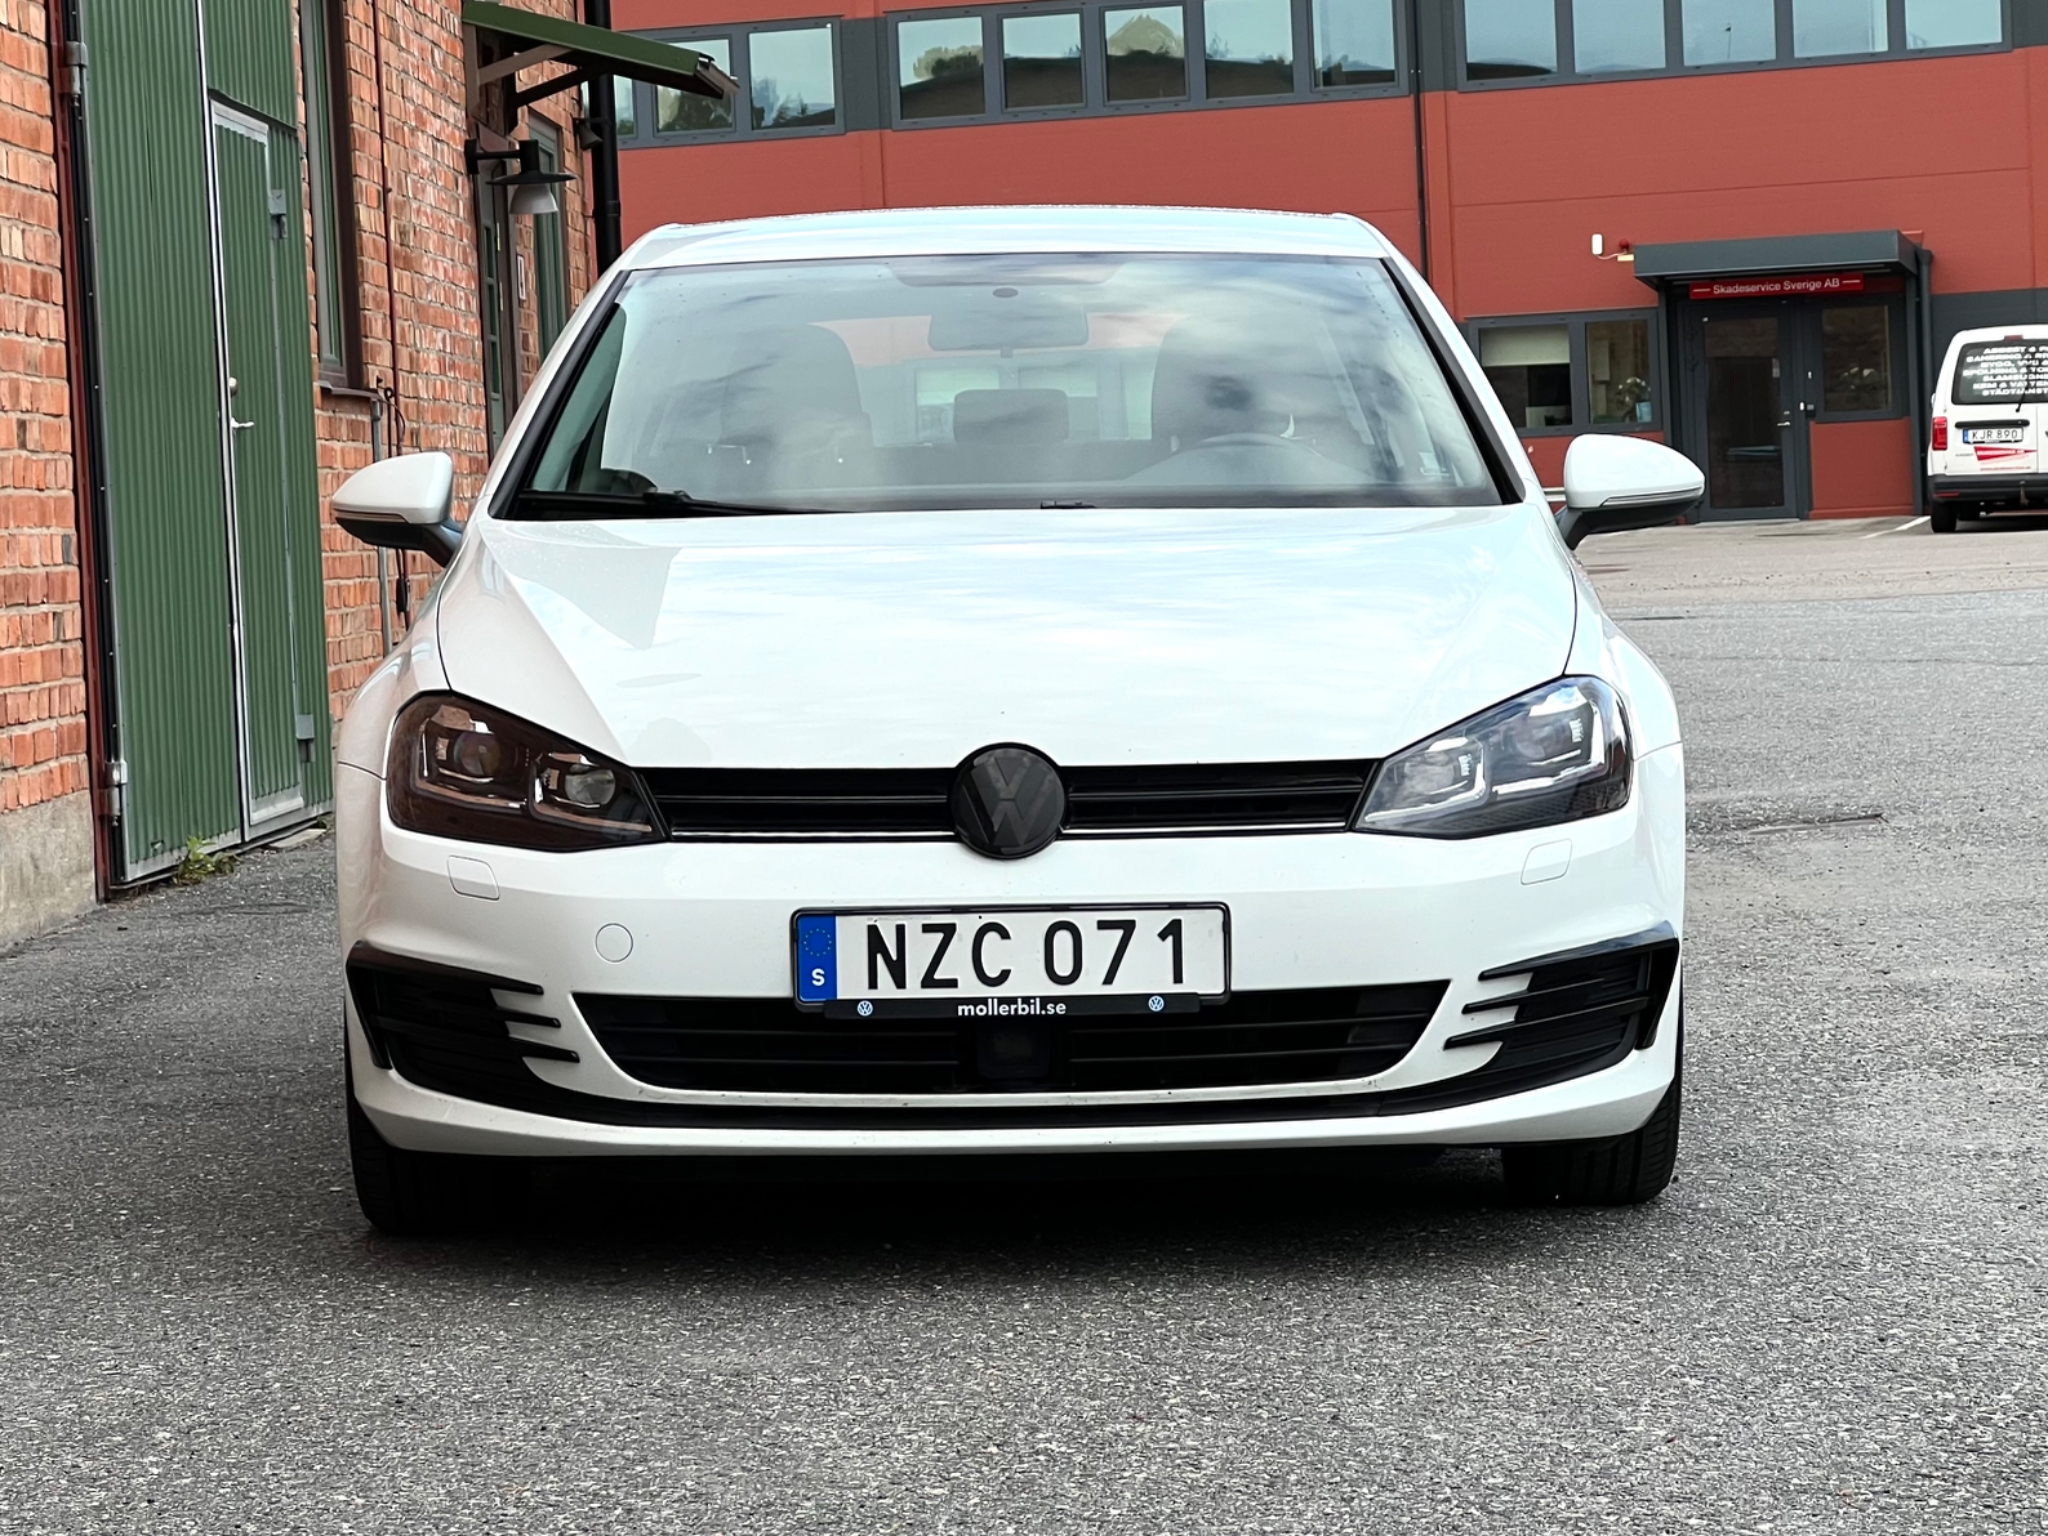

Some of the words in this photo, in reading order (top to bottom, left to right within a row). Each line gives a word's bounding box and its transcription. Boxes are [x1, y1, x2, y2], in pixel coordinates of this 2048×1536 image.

[1713, 282, 1781, 294] Skadeservice
[1783, 280, 1822, 291] Sverige
[1824, 278, 1839, 288] AB
[1962, 367, 2018, 376] SPOLNING
[1972, 430, 1993, 440] KJR
[1996, 429, 2018, 439] 890
[867, 921, 1012, 990] NZC
[1043, 918, 1184, 986] 071
[812, 968, 825, 986] S
[957, 998, 1067, 1017] mollerbil.se
